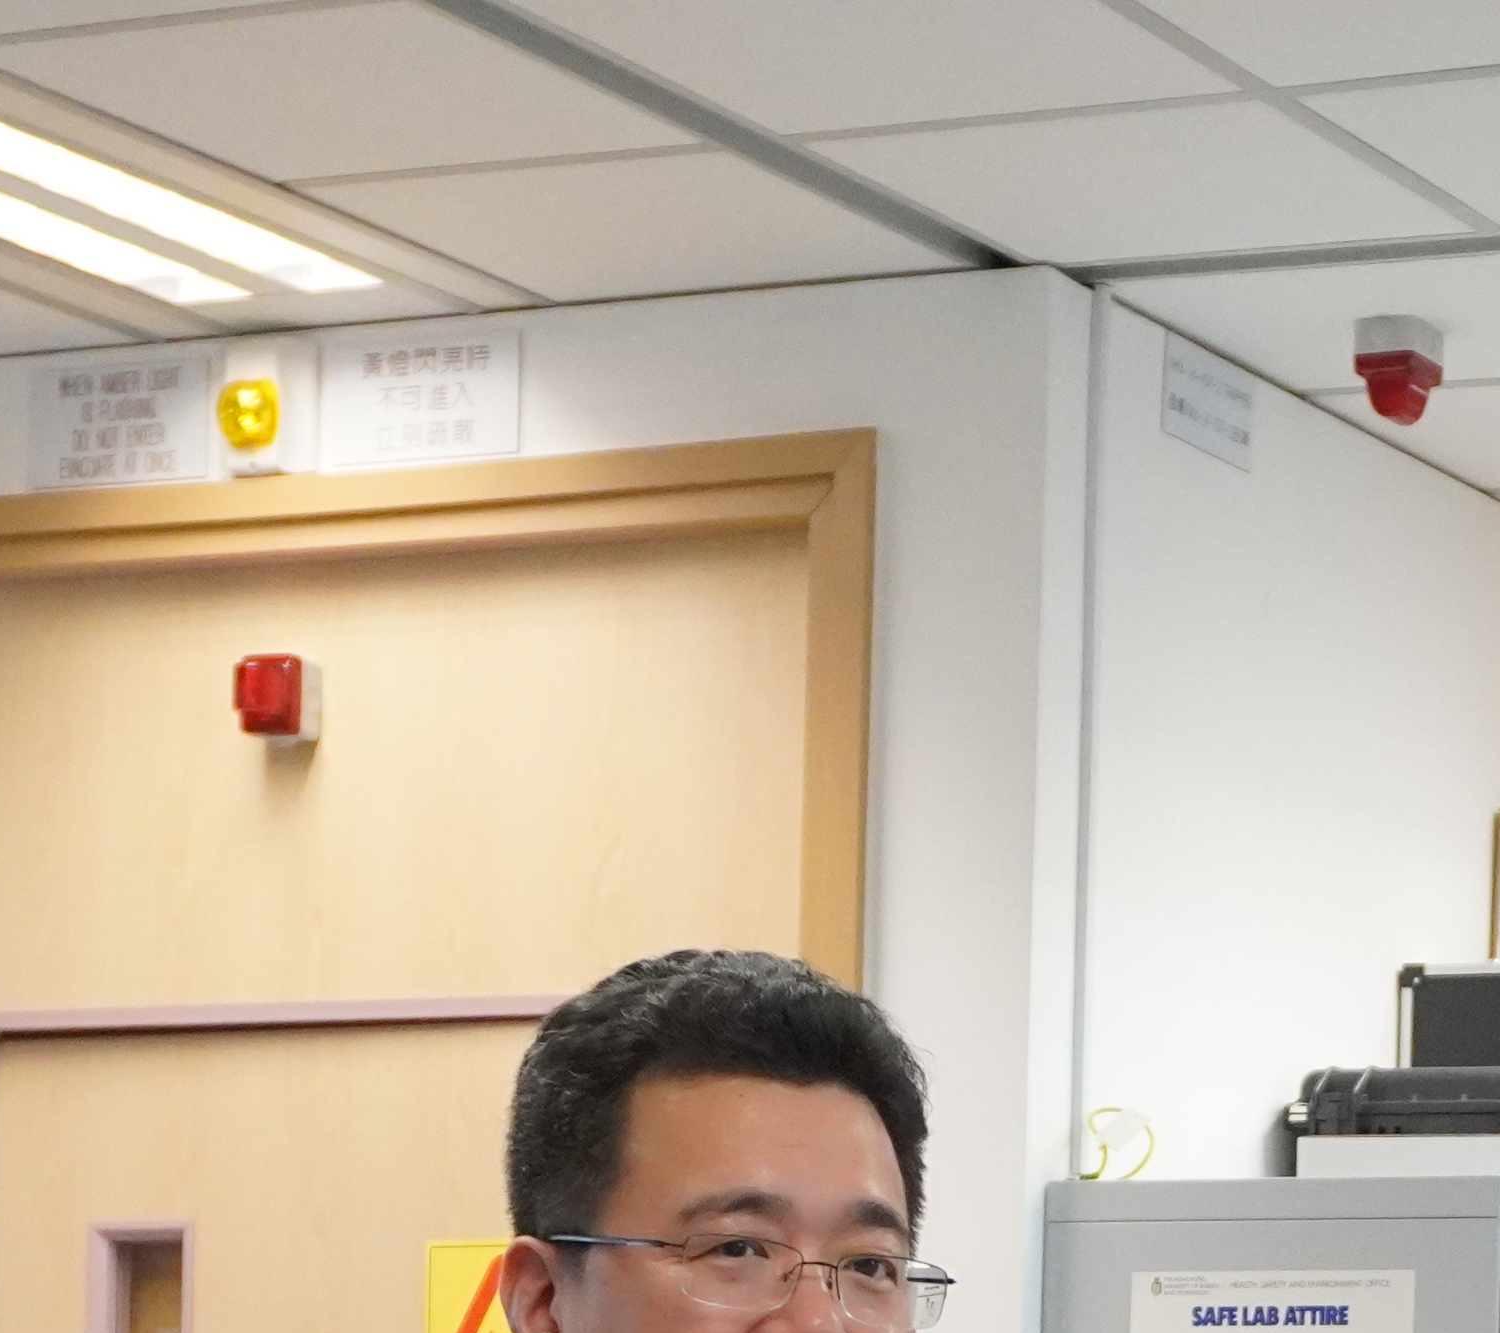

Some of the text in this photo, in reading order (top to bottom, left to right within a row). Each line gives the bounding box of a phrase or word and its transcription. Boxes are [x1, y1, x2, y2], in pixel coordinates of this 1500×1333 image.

[376, 382, 474, 412] 不可進入
[1191, 1305, 1349, 1326] SAFE LAB ATTIRE
